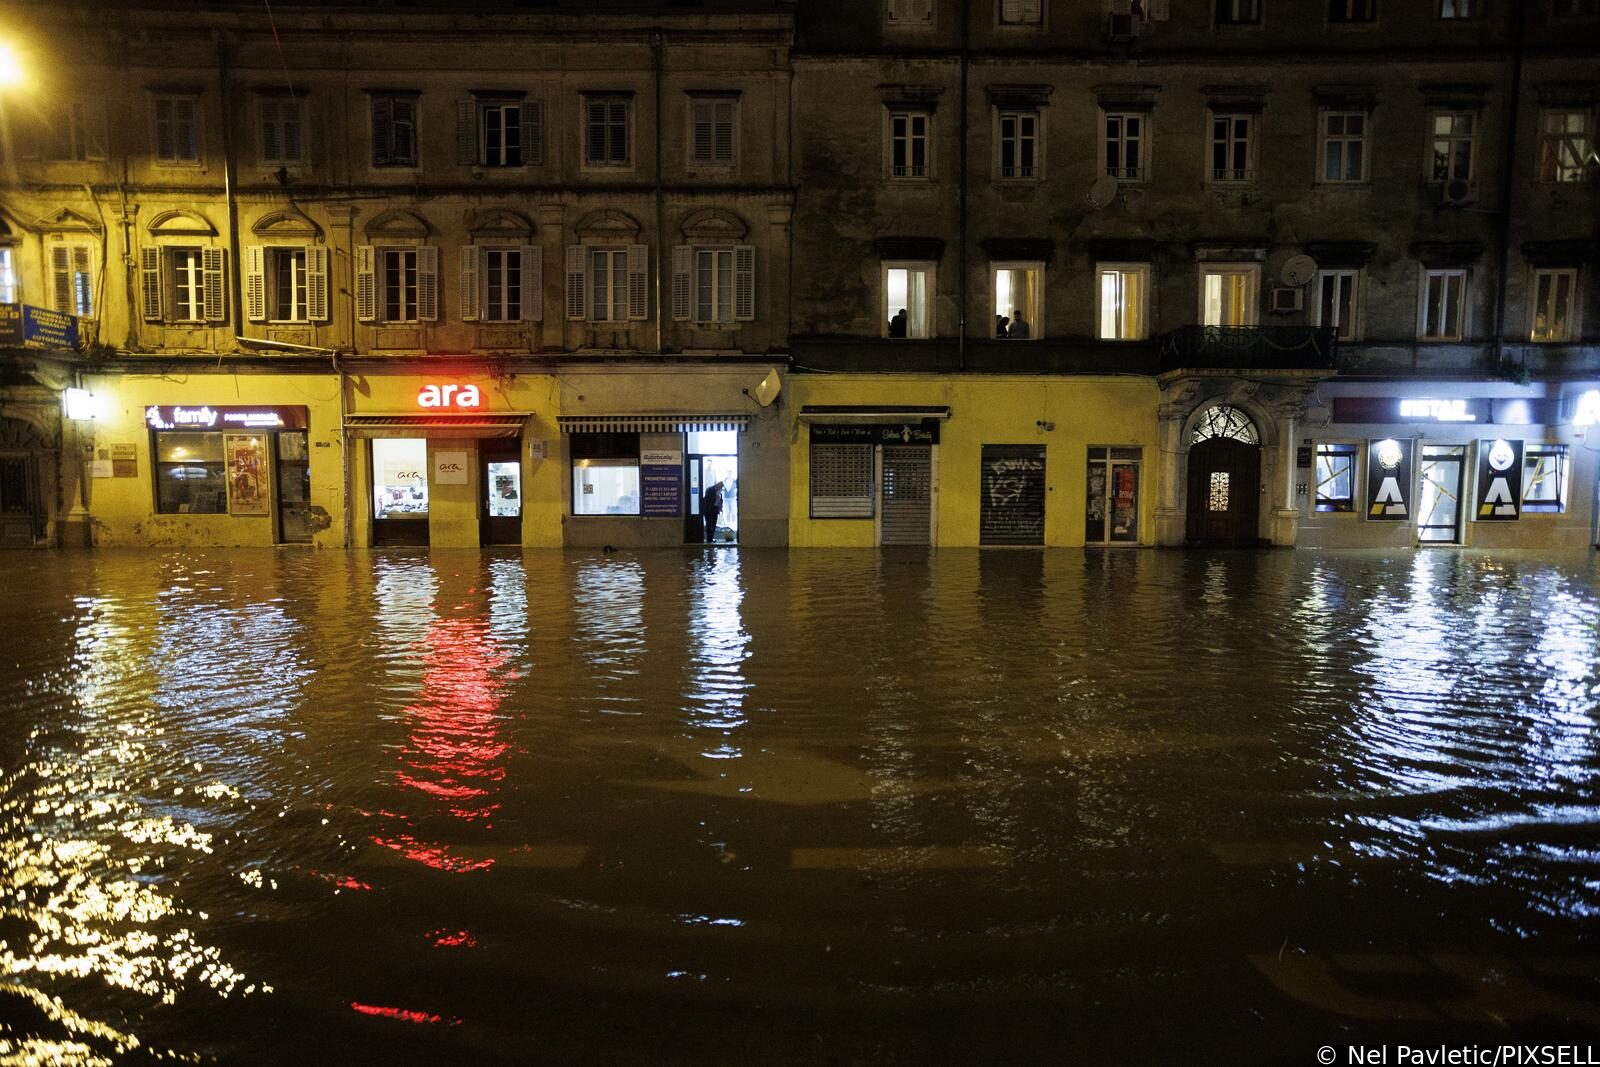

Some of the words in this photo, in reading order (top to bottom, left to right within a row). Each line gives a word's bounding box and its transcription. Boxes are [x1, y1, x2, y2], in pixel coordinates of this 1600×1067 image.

[418, 384, 480, 407] ara
[173, 406, 218, 427] family
[439, 463, 463, 471] ara
[397, 471, 423, 480] ara
